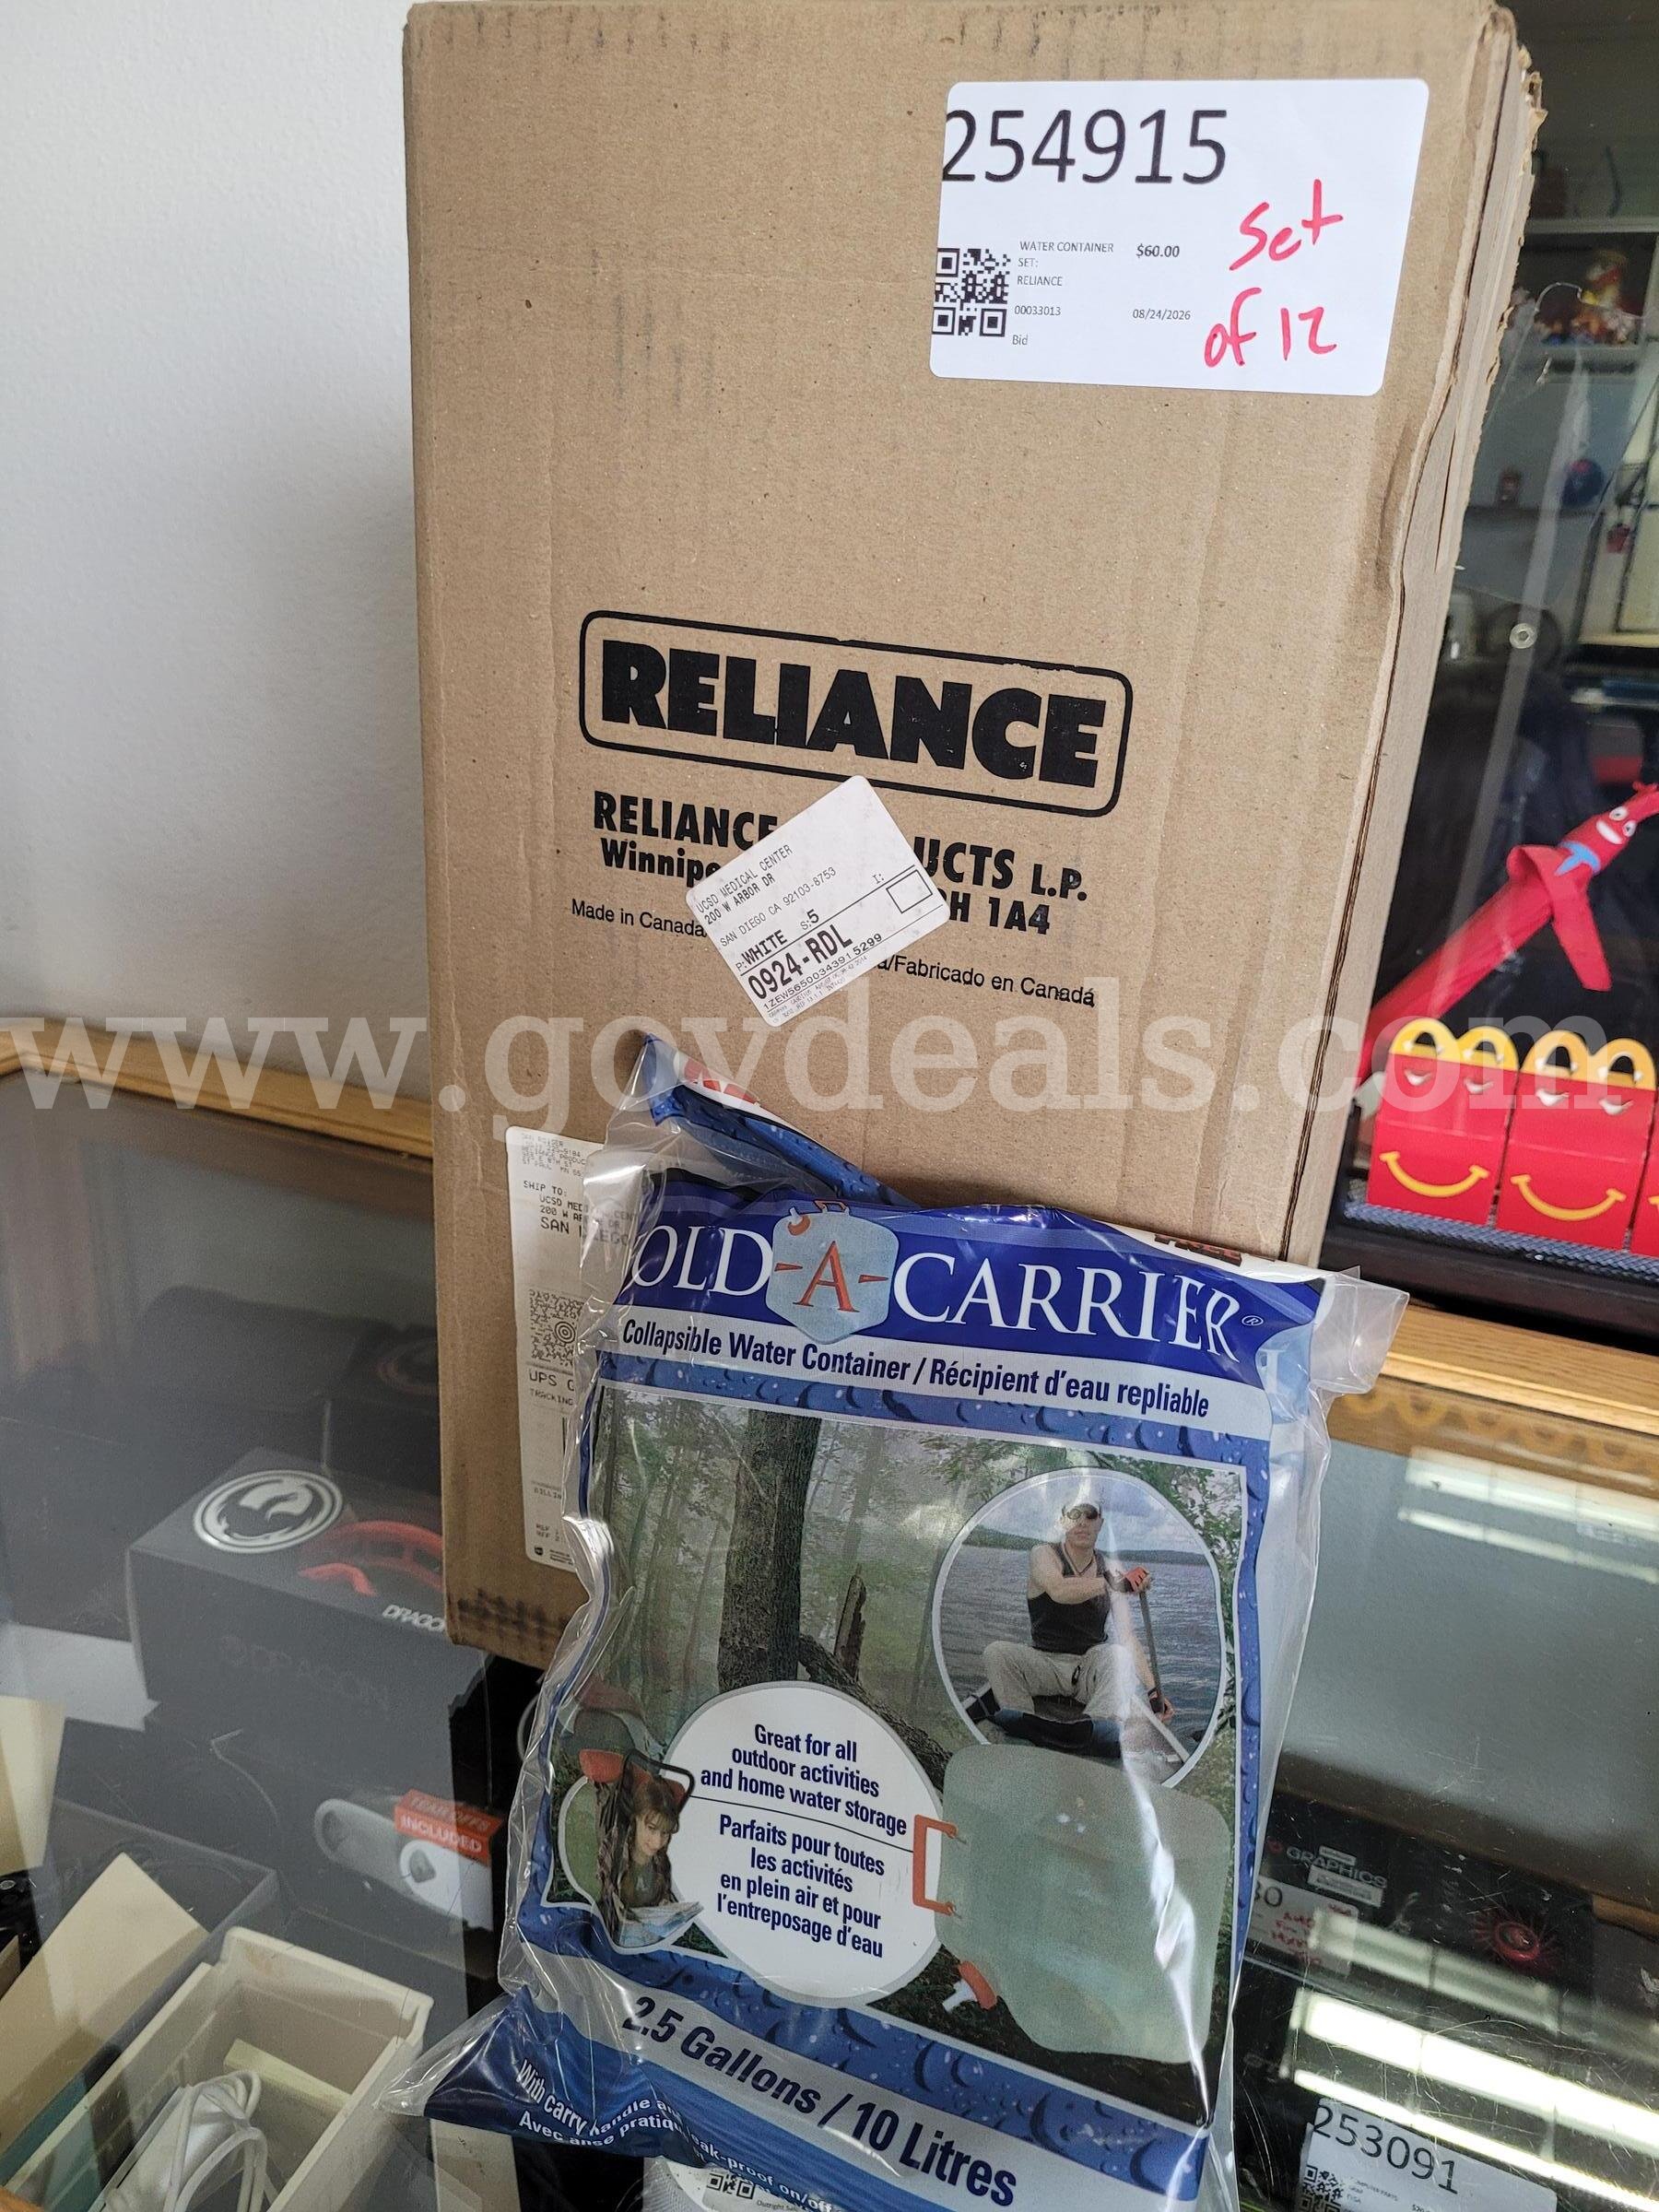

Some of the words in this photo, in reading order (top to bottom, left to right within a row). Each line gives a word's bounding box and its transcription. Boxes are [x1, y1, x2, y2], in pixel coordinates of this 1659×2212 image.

[942, 109, 1228, 184] 254915
[1019, 241, 1054, 252] WATER
[1056, 241, 1114, 253] CONTAINER
[1230, 179, 1344, 271] Set
[1018, 257, 1039, 267] SET:
[1136, 243, 1180, 258] $60.00
[1017, 276, 1063, 287] RELIANCE
[1014, 305, 1061, 316] 00033013
[1132, 309, 1191, 320] 08/24/2026
[1204, 288, 1263, 368] of
[1012, 334, 1028, 346] Bid
[602, 639, 1108, 789] RELIANCE
[594, 790, 778, 851] RELIANCE
[1030, 863, 1088, 902] L.P.
[600, 837, 722, 888] Winnipe
[696, 896, 719, 914] UCSD
[721, 869, 759, 898] MEDICAL
[759, 844, 794, 873] CENTER
[704, 909, 723, 924] 200
[723, 901, 732, 913] W
[735, 881, 766, 907] ARBOR
[764, 872, 776, 888] DR
[720, 929, 739, 947] SAN
[740, 912, 767, 935] DIEGO
[769, 901, 782, 915] CA
[782, 866, 837, 907] 92103-8753
[987, 895, 1051, 935] 1A4
[571, 898, 615, 923] Made
[620, 908, 634, 925] in
[991, 975, 1015, 993] en
[1020, 977, 1096, 1007] Canadá
[747, 924, 853, 1000] 0924-RDL
[524, 1180, 546, 1192] SHIP
[551, 1185, 568, 1197] TO:
[540, 1194, 562, 1206] UCSD
[540, 1205, 557, 1216] 200
[540, 1217, 570, 1235] SAN
[529, 1369, 557, 1386] UPS
[622, 1318, 722, 1356] Collapsible
[729, 1332, 796, 1366] Water
[802, 1343, 911, 1383] Container
[929, 1359, 1040, 1395] Récipient
[1117, 1384, 1210, 1418] repliable
[755, 1724, 801, 1752] Great
[806, 1734, 831, 1757] for
[835, 1739, 857, 1762] all
[732, 1747, 795, 1777] outdoor
[800, 1763, 879, 1797] activities
[700, 1768, 733, 1789] and
[737, 1771, 784, 1799] home
[789, 1787, 841, 1813] water
[845, 1799, 907, 1837] storage
[400, 1814, 482, 1853] INCLUDED
[720, 1814, 787, 1846] Parfaits
[792, 1832, 831, 1856] pour
[834, 1841, 885, 1876] toutes
[751, 1847, 776, 1872] les
[782, 1858, 853, 1892] activités
[721, 1873, 741, 1891] en
[747, 1876, 790, 1901] plein
[795, 1886, 818, 1909] air
[822, 1896, 839, 1916] et
[842, 1901, 881, 1929] pour
[516, 2059, 546, 2104] With
[543, 2093, 587, 2136] carry
[622, 1996, 683, 2043] 2.5
[680, 2025, 821, 2114] Gallons
[852, 2101, 900, 2152] 10
[899, 2121, 1018, 2208] Litres
[518, 2111, 564, 2141] Avec
[569, 2135, 615, 2147] anse
[1313, 2104, 1458, 2194] 253091
